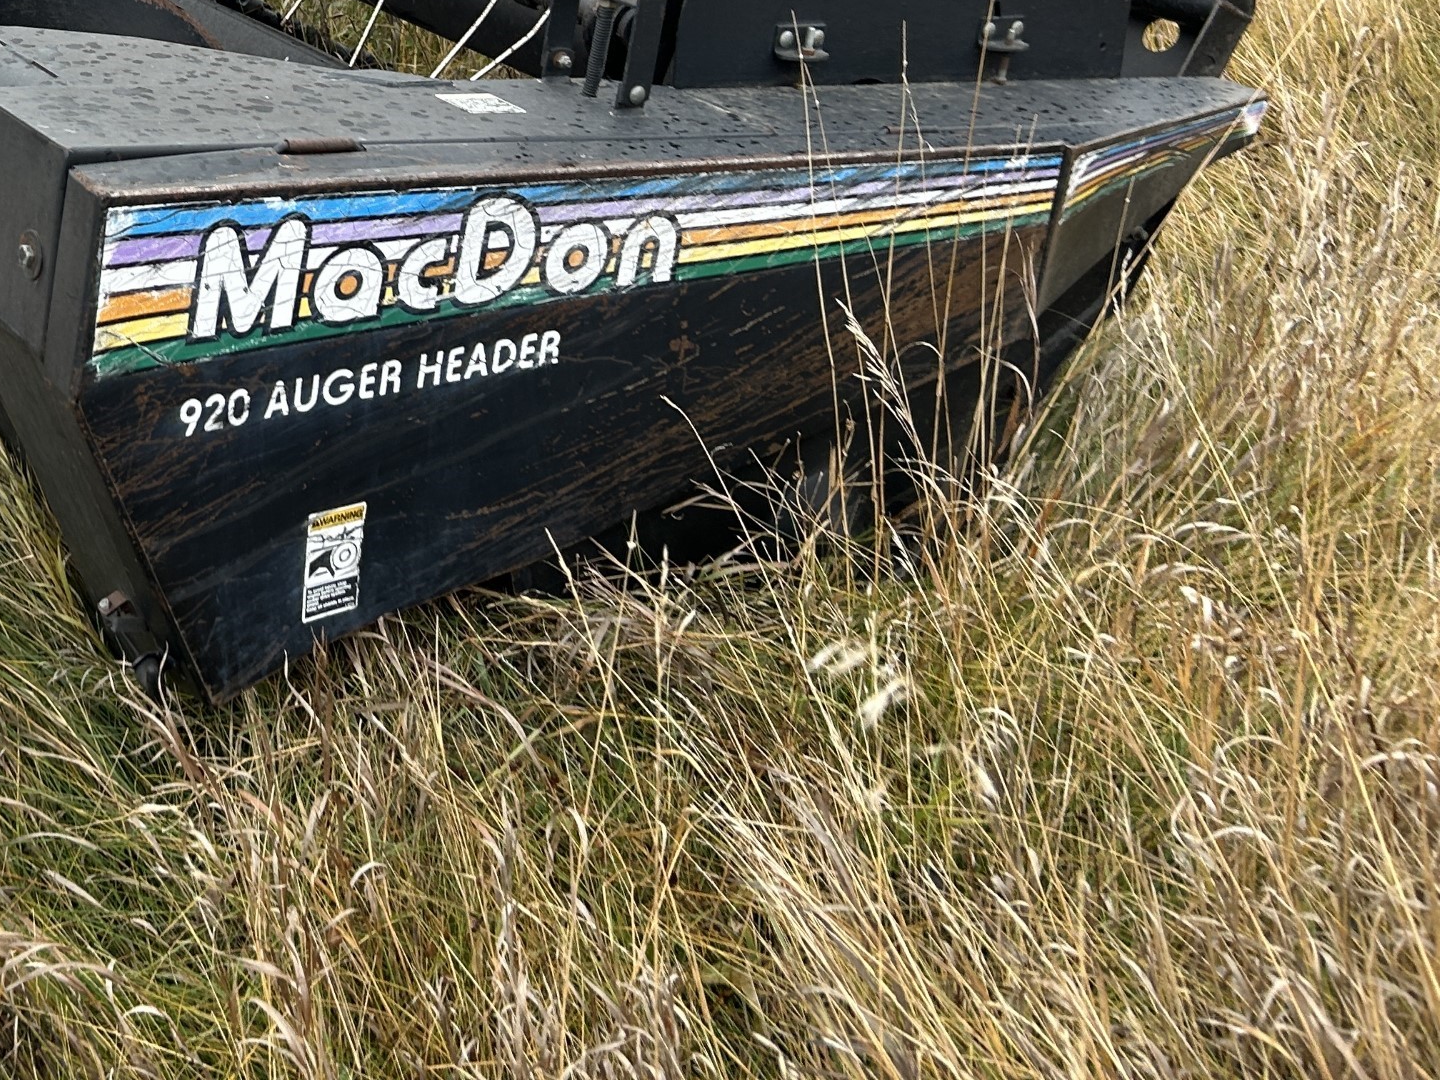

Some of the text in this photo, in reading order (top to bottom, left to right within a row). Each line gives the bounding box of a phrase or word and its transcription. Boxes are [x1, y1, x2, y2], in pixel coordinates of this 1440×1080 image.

[188, 192, 681, 340] MacDon
[179, 329, 561, 437] 920 AUGER HEADER
[320, 508, 364, 526] WARNING
